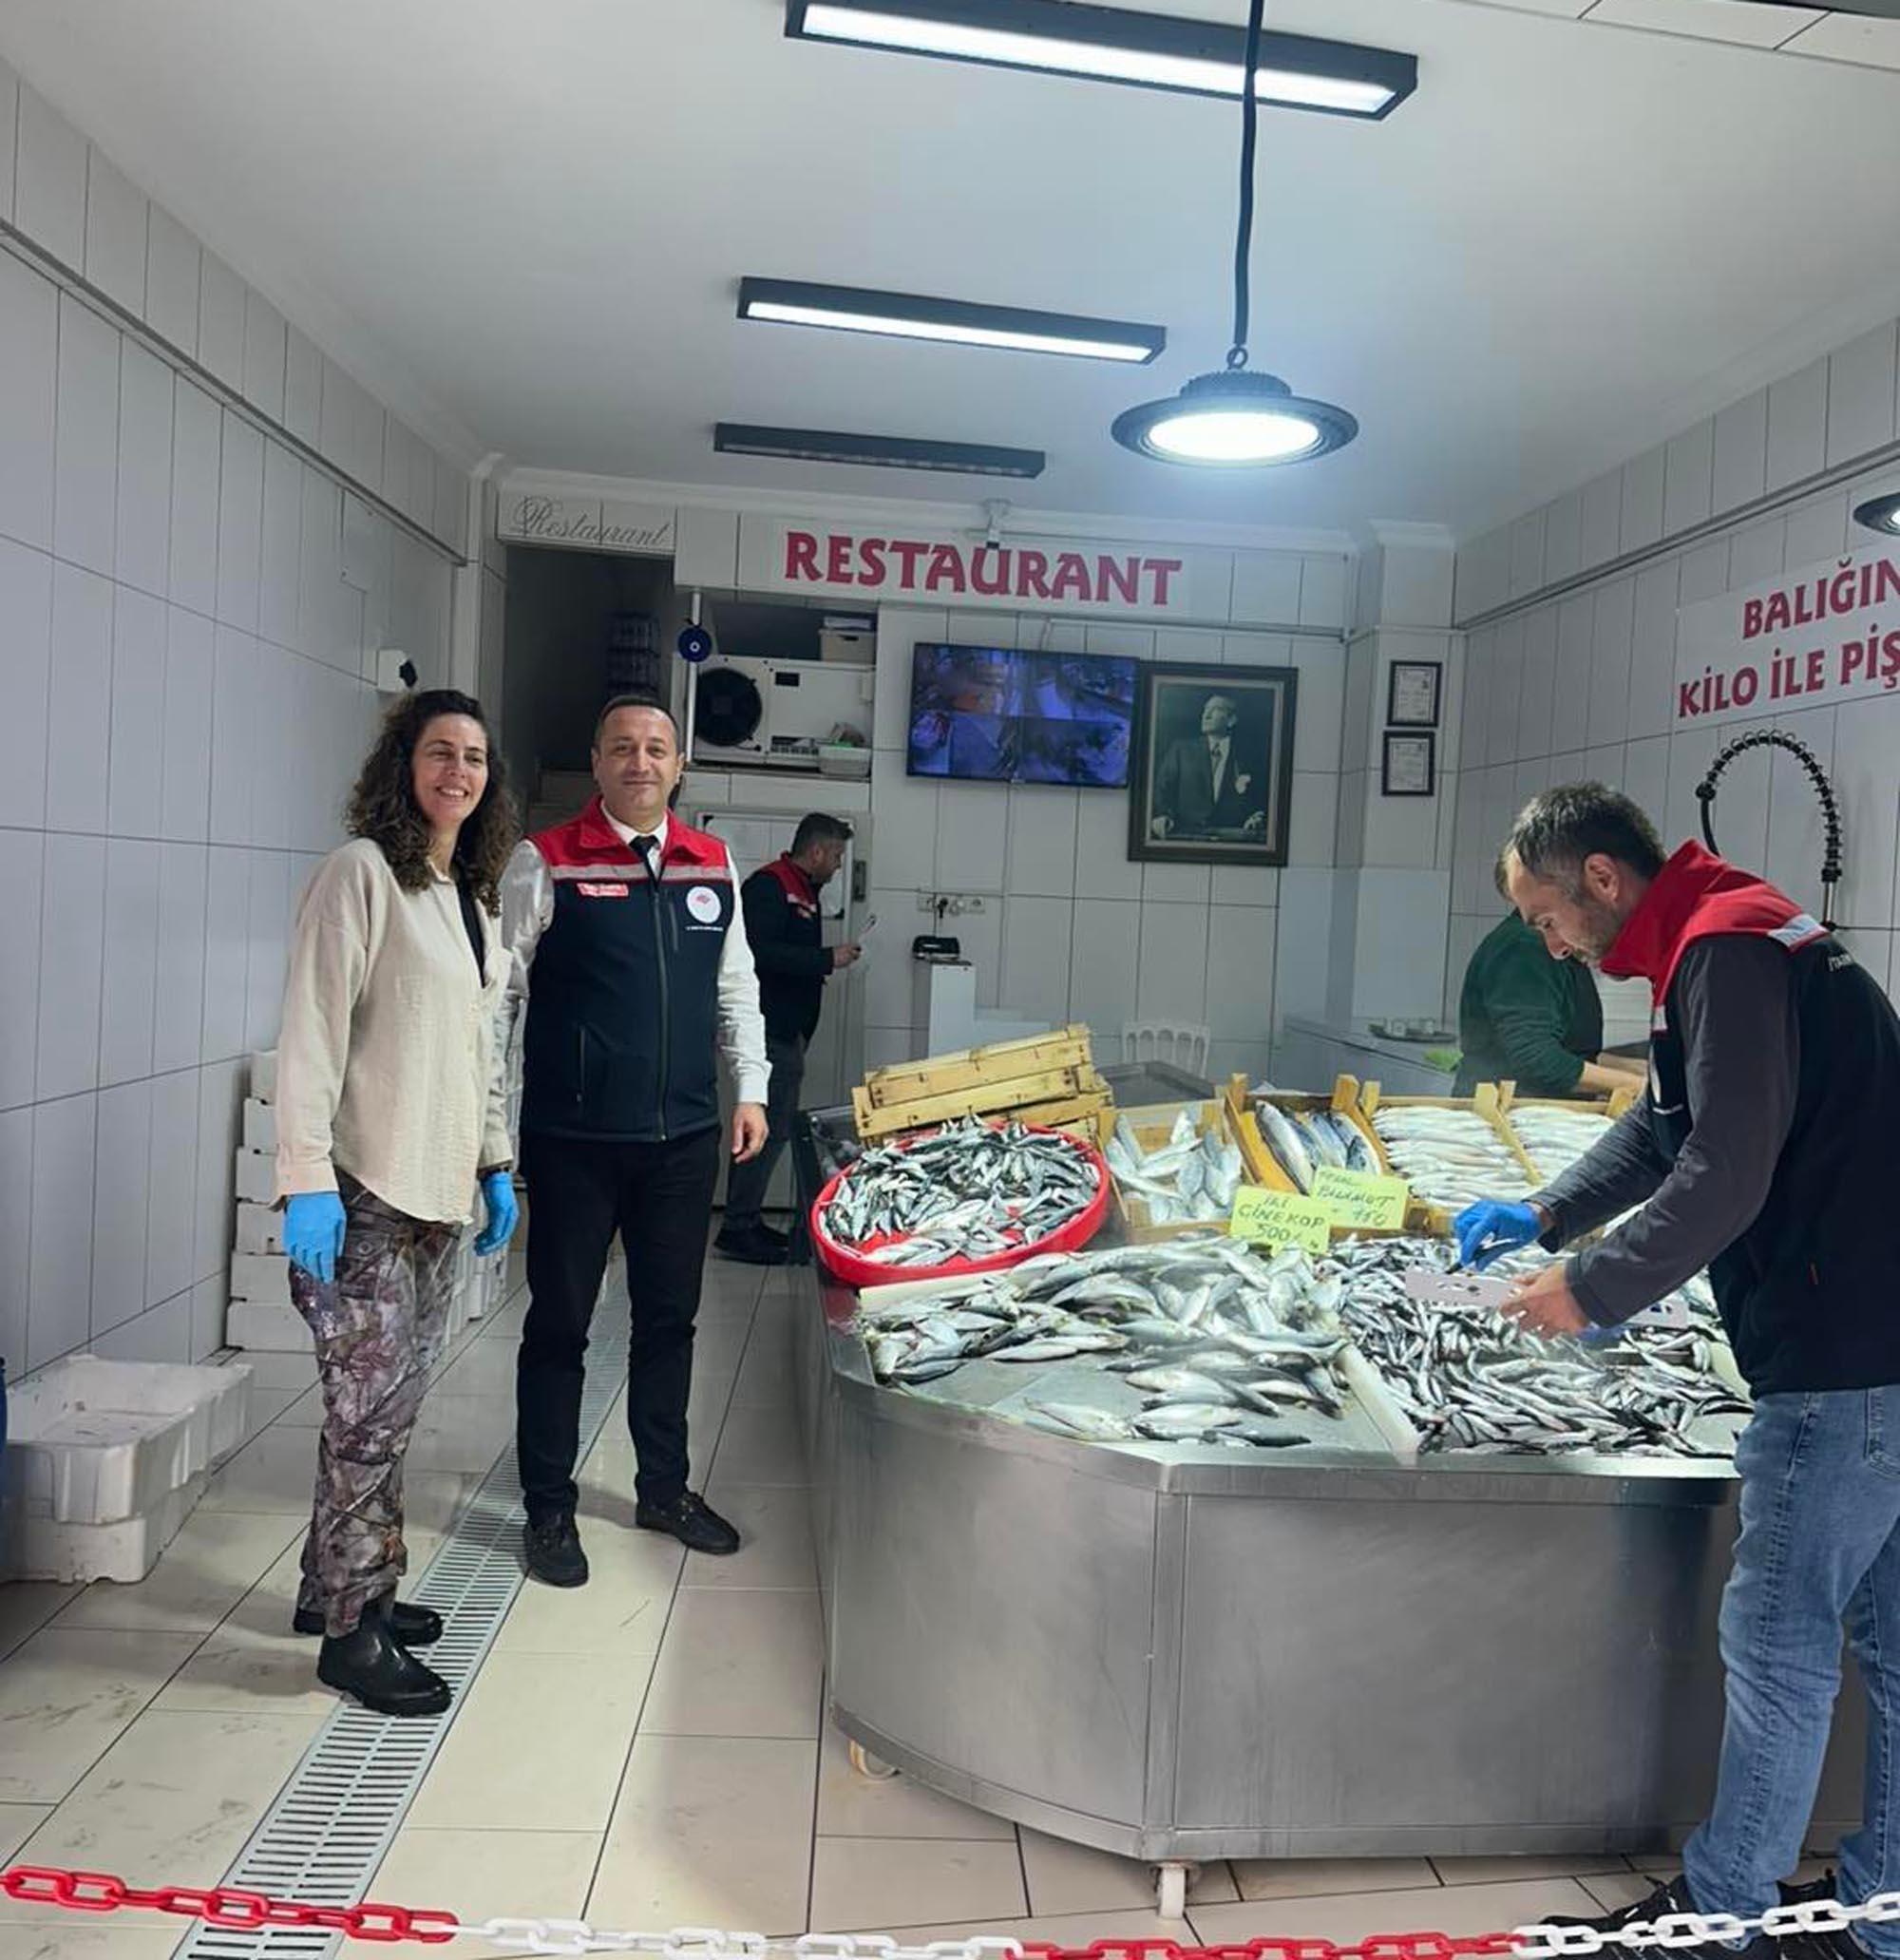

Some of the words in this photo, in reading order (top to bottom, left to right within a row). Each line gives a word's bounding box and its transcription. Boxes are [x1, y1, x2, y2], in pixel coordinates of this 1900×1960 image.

[784, 530, 1184, 606] RESTAURANT
[1678, 665, 1758, 719] KİLO
[1769, 647, 1826, 700] İLE
